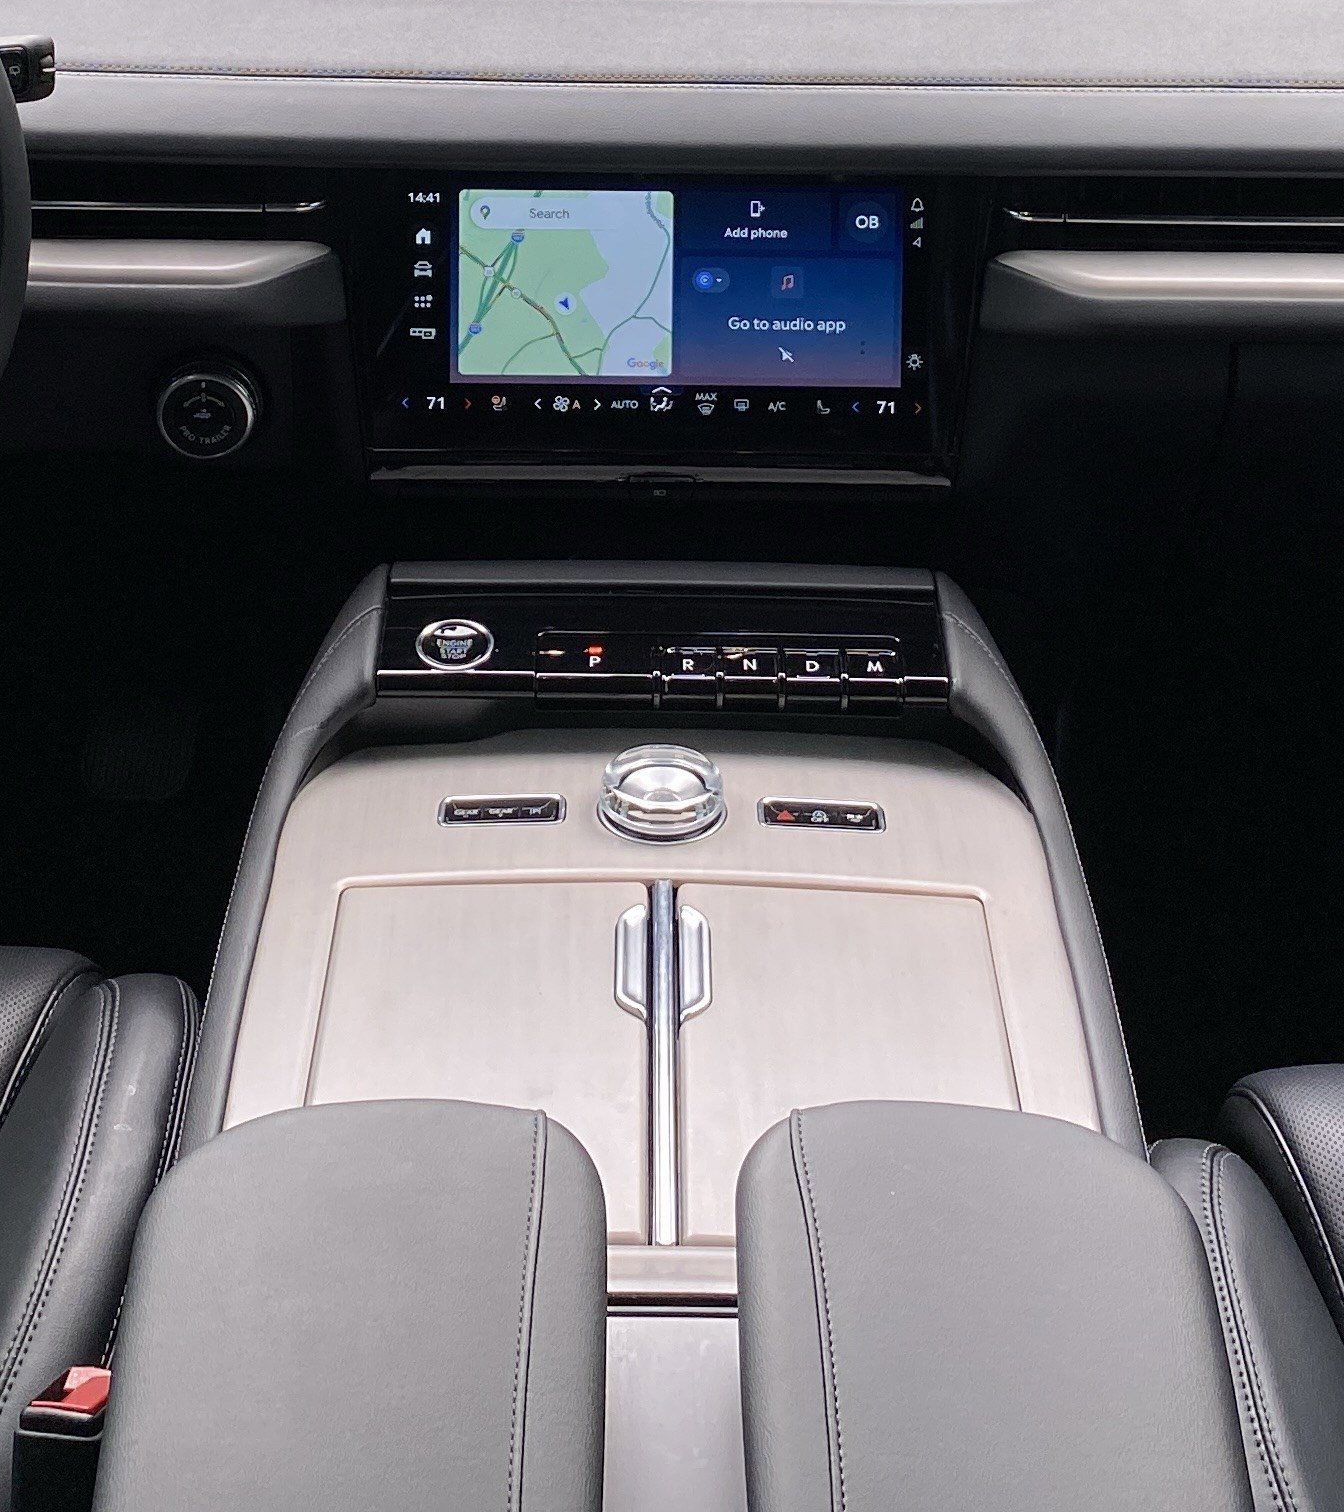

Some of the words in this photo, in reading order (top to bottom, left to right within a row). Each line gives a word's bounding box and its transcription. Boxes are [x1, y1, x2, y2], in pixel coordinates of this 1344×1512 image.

[407, 192, 441, 203] 14:41
[529, 208, 570, 219] Search
[855, 215, 879, 229] OB
[724, 227, 748, 238] Add
[751, 227, 788, 240] phone
[728, 316, 749, 330] Go
[752, 317, 769, 330] to
[772, 317, 814, 331] audio
[816, 320, 846, 334] app
[626, 357, 665, 371] Google
[695, 392, 718, 401] MAX
[426, 396, 445, 410] 71
[611, 400, 639, 410] AUTO
[768, 401, 786, 412] A/C
[876, 400, 895, 414] 71
[436, 638, 473, 648] ENGINE
[439, 647, 468, 655] START
[588, 655, 601, 669] P
[682, 659, 694, 671] R
[743, 659, 757, 671] N
[806, 661, 820, 673] D
[867, 661, 883, 673] M
